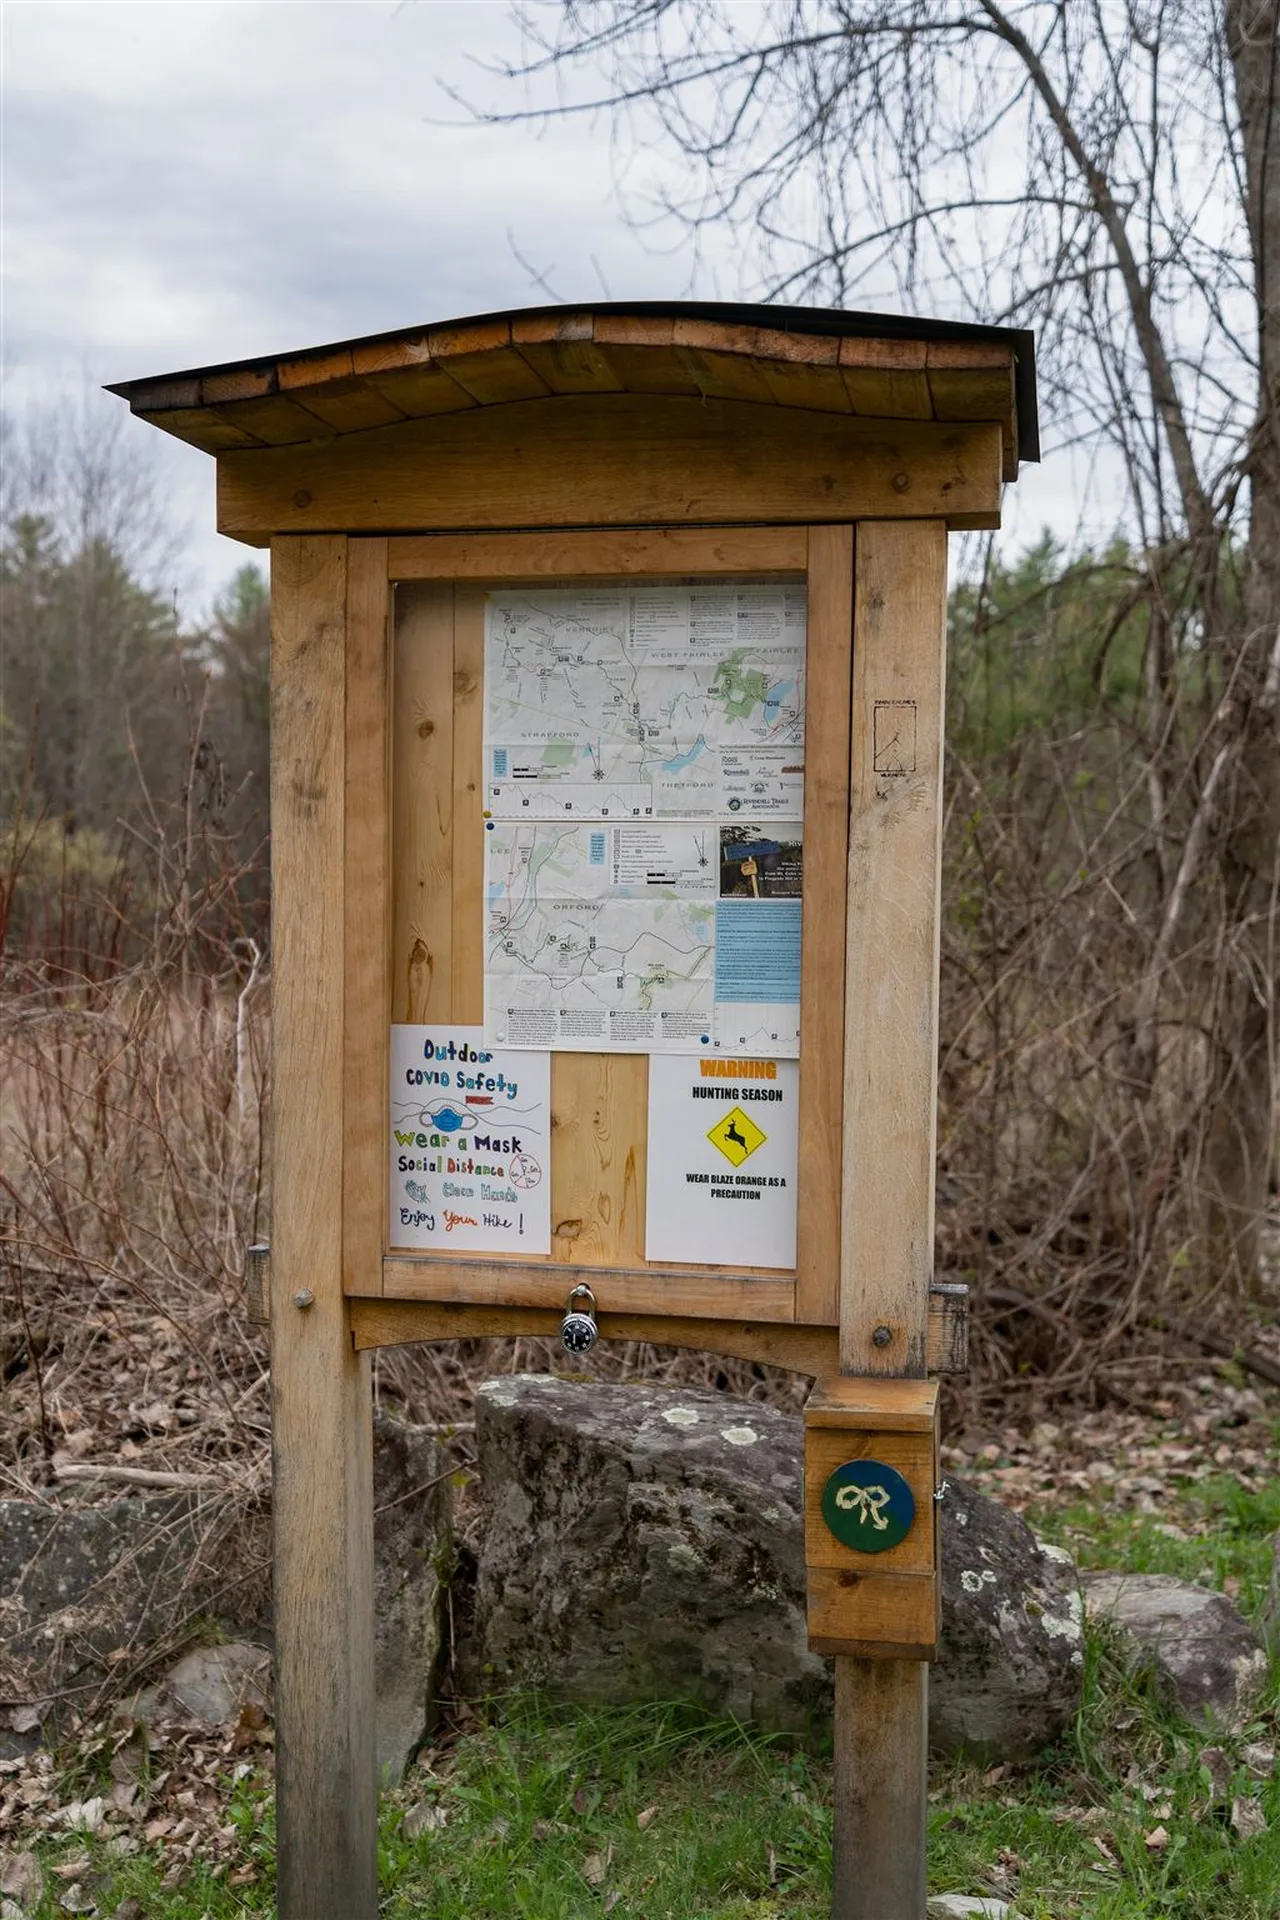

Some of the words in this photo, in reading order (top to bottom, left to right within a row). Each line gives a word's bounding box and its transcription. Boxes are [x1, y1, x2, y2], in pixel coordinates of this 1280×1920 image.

[700, 1059, 777, 1080] WARNING
[456, 1071, 518, 1100] Safety
[692, 1087, 739, 1100] HUNTING
[741, 1088, 783, 1101] SEASON
[393, 1130, 450, 1149] Wear
[457, 1137, 467, 1151] a
[474, 1135, 522, 1153] Mask
[398, 1155, 442, 1173] Social
[447, 1158, 504, 1177] Distance
[686, 1173, 709, 1184] WEAR
[711, 1174, 734, 1185] BLAZE
[735, 1175, 767, 1186] ORANGE
[768, 1177, 780, 1187] AS
[780, 1177, 786, 1187] A
[710, 1188, 761, 1200] PRECAUTION
[400, 1207, 435, 1231] Enjoy
[442, 1209, 478, 1231] Your
